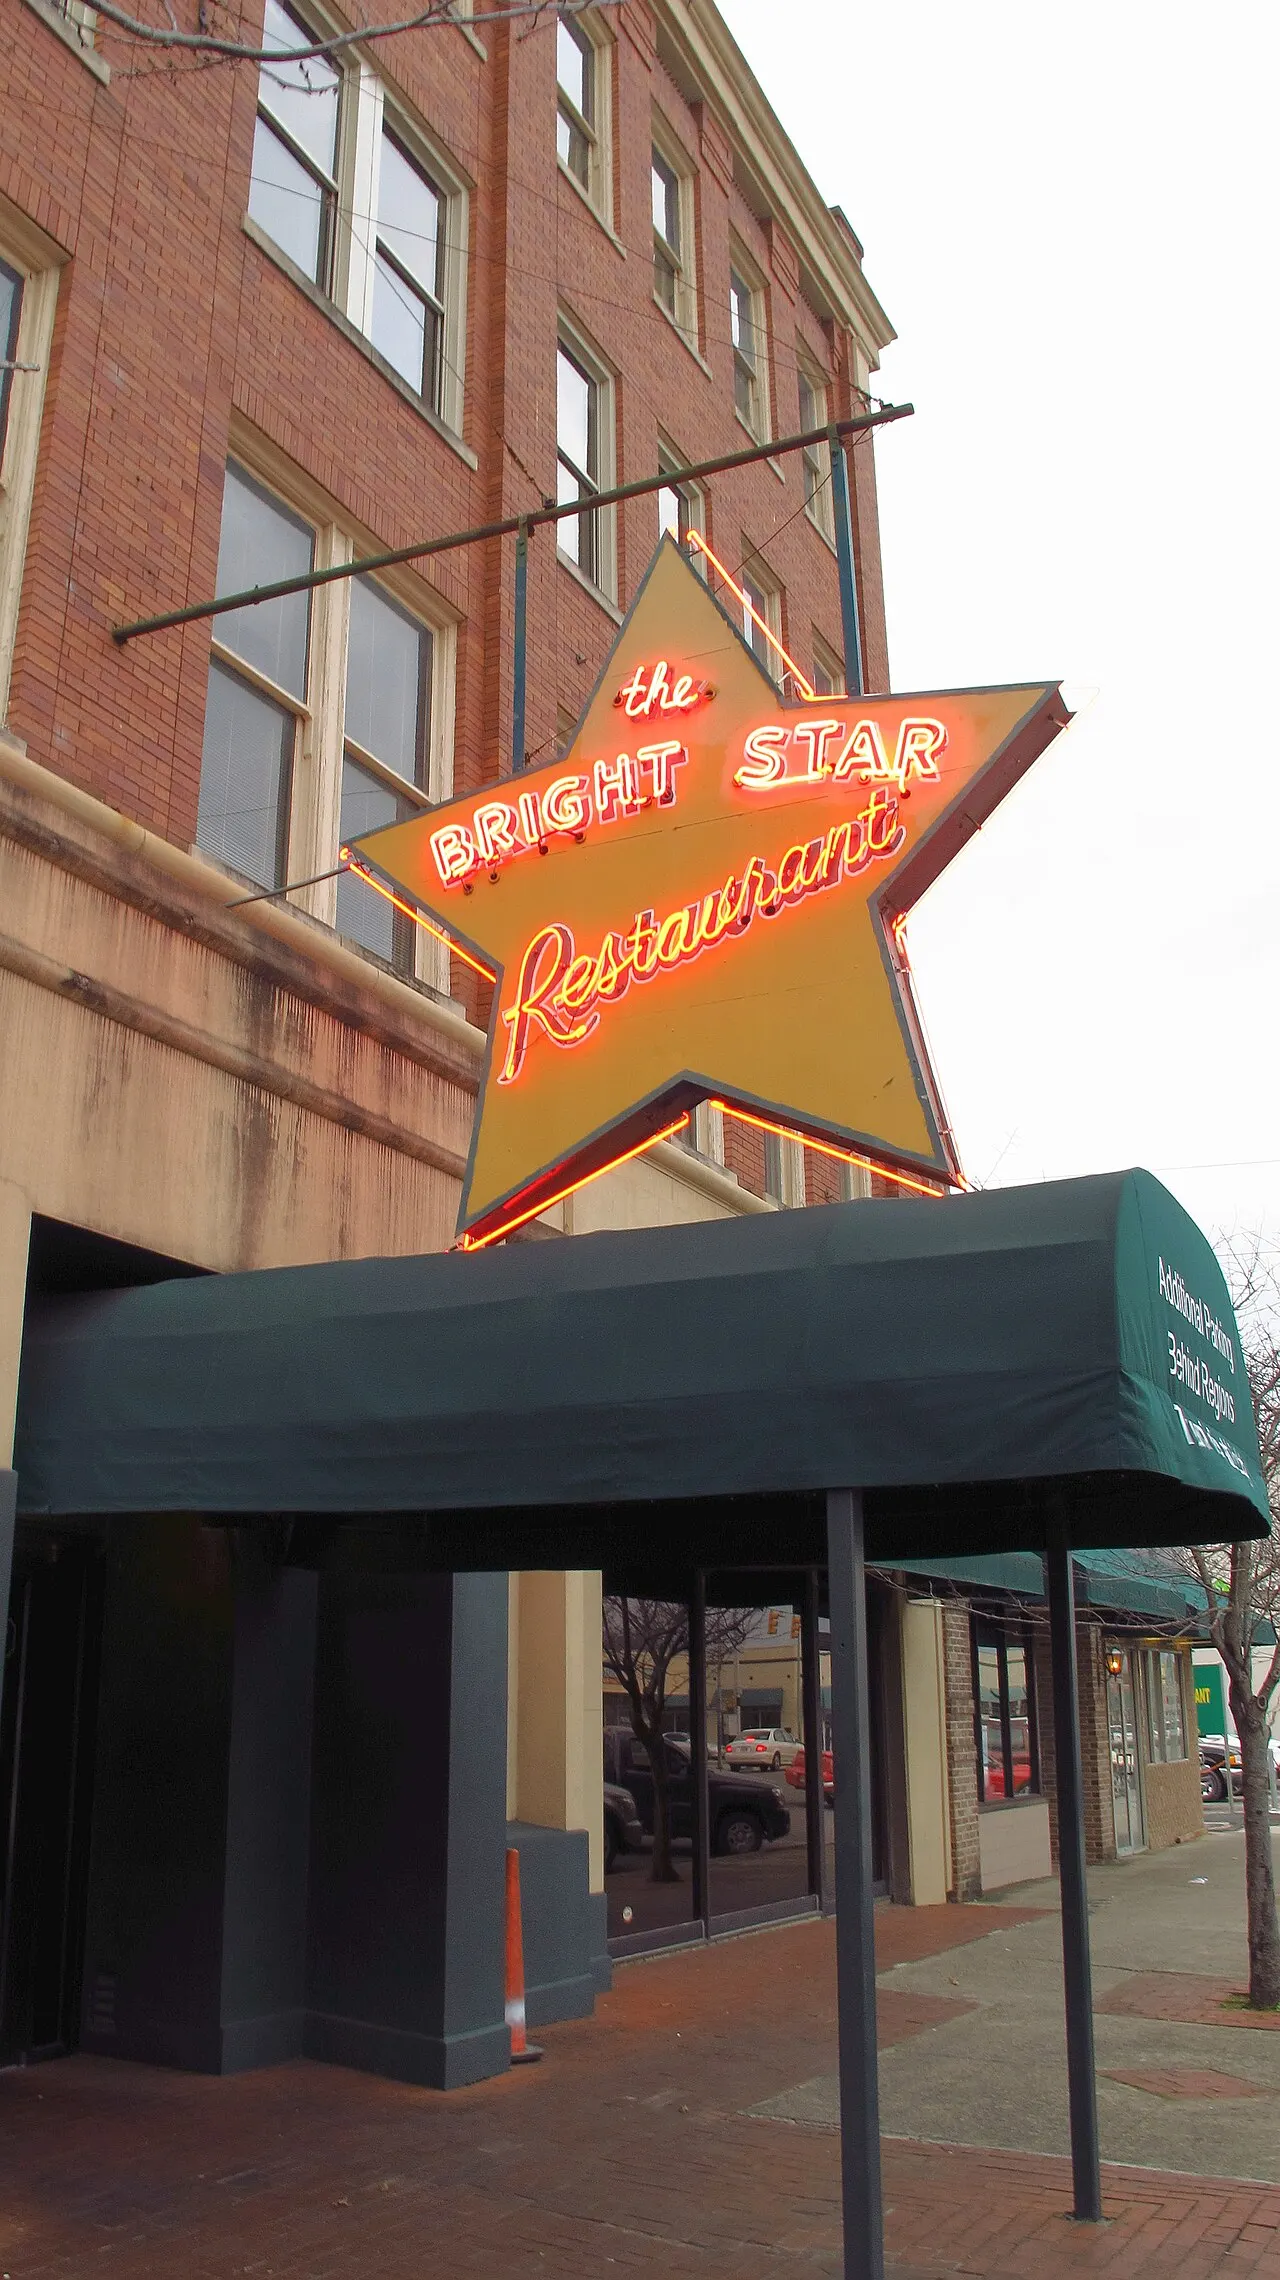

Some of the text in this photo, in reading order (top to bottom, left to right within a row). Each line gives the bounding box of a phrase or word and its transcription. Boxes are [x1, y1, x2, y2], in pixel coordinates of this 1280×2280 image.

[620, 660, 701, 719] the
[429, 716, 948, 892] BRIGHT STAR
[496, 788, 907, 1085] Restaurant
[1157, 1254, 1205, 1337] Additional
[1203, 1302, 1236, 1375] Parking
[1167, 1330, 1236, 1424] Behind Regions
